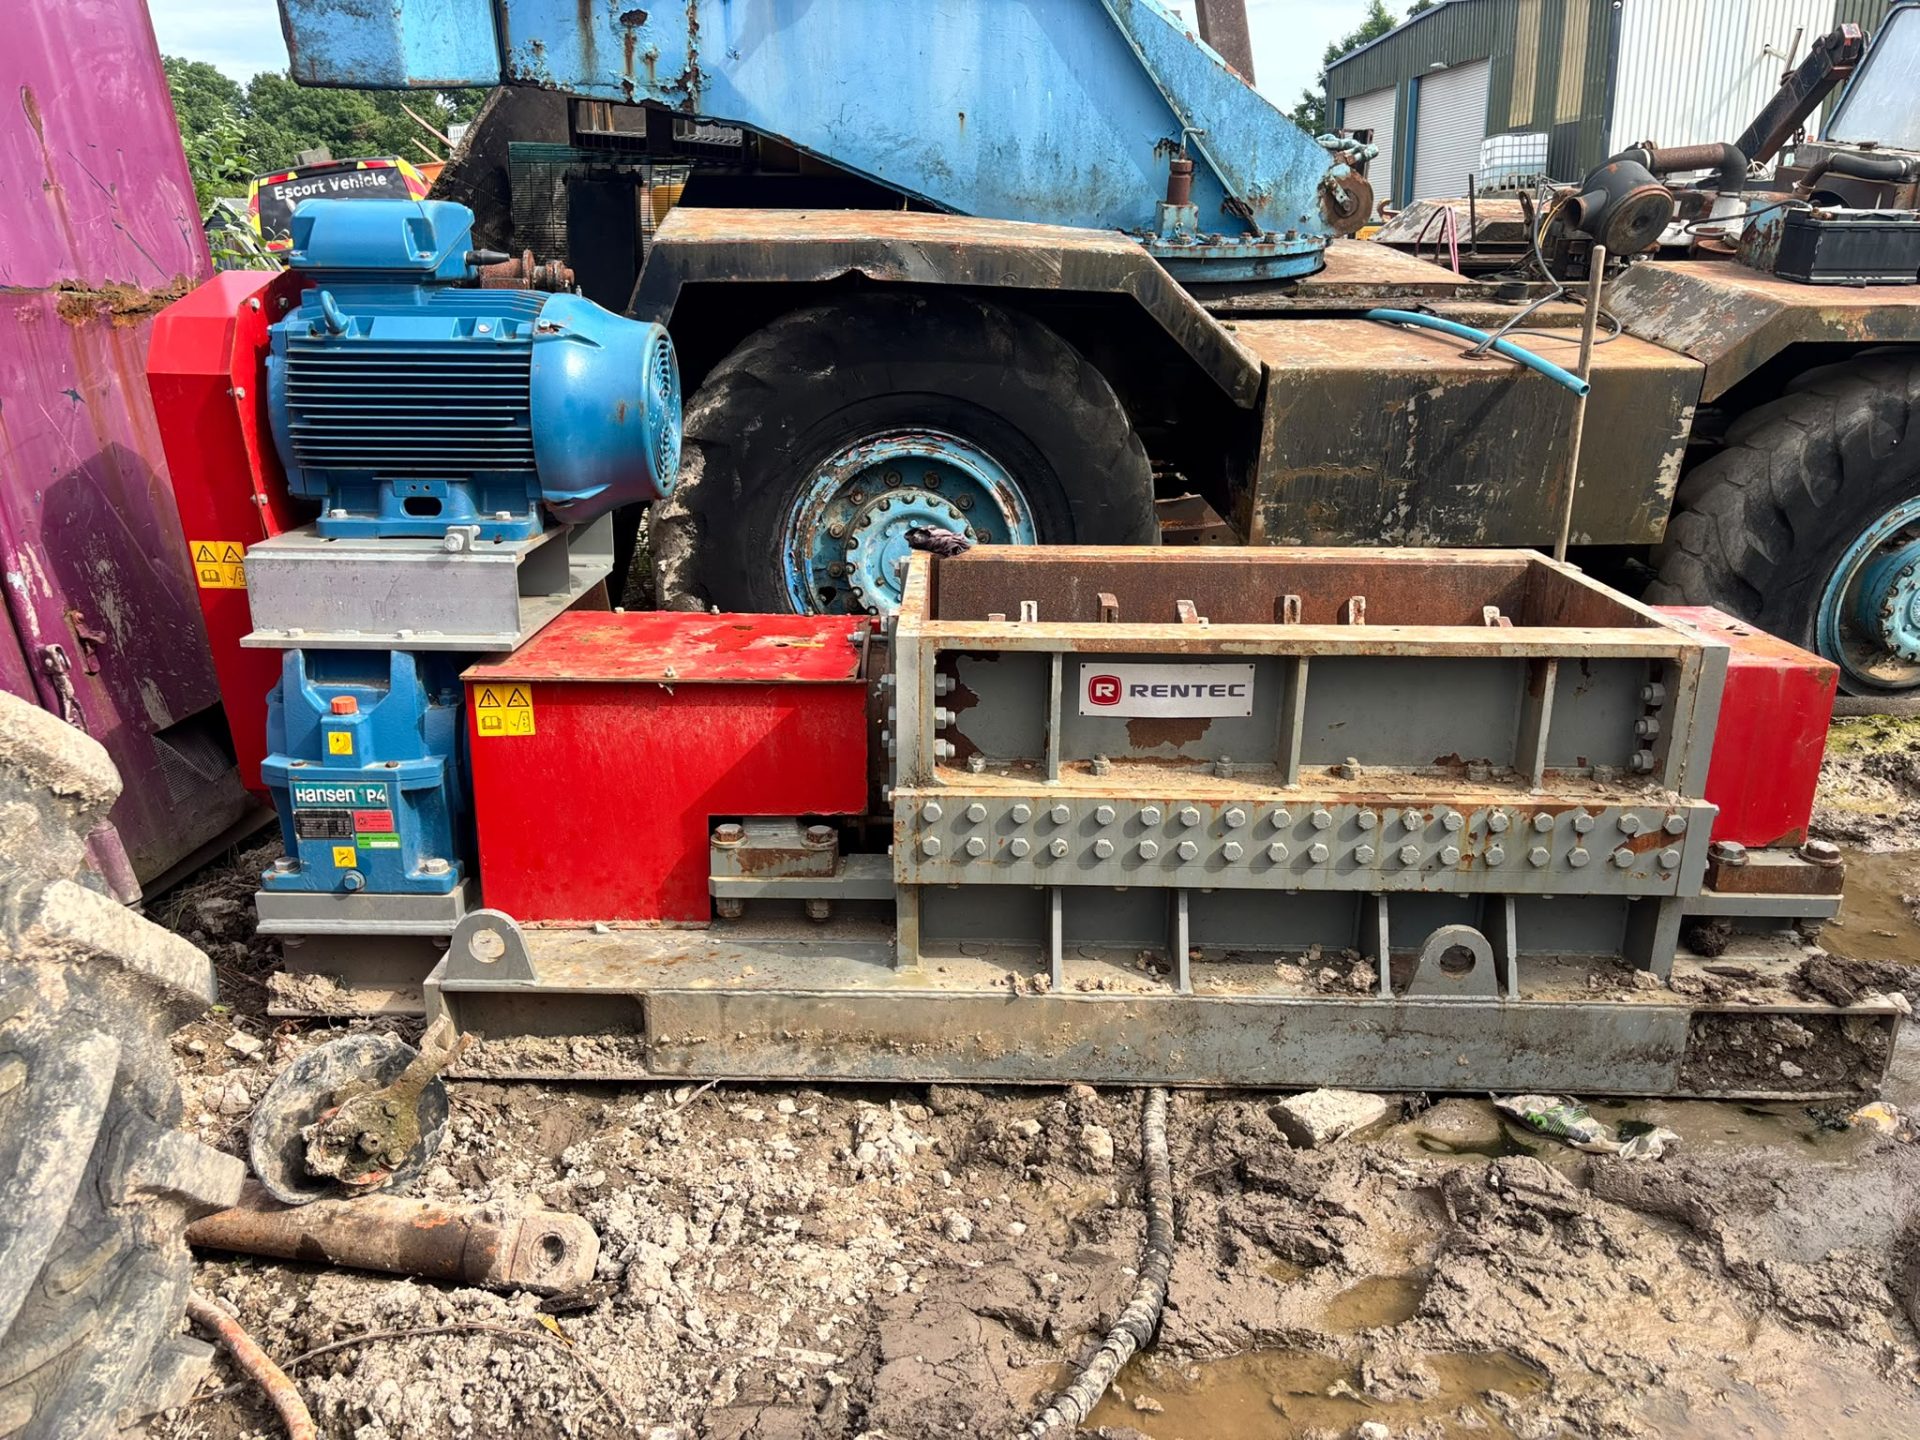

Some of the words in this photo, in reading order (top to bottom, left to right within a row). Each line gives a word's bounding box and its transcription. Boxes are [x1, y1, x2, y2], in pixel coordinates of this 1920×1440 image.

[274, 183, 326, 200] Escort
[330, 172, 387, 191] Vehicle
[1130, 684, 1246, 698] RENTEC
[295, 788, 356, 803] Hansen
[366, 790, 386, 803] P4
